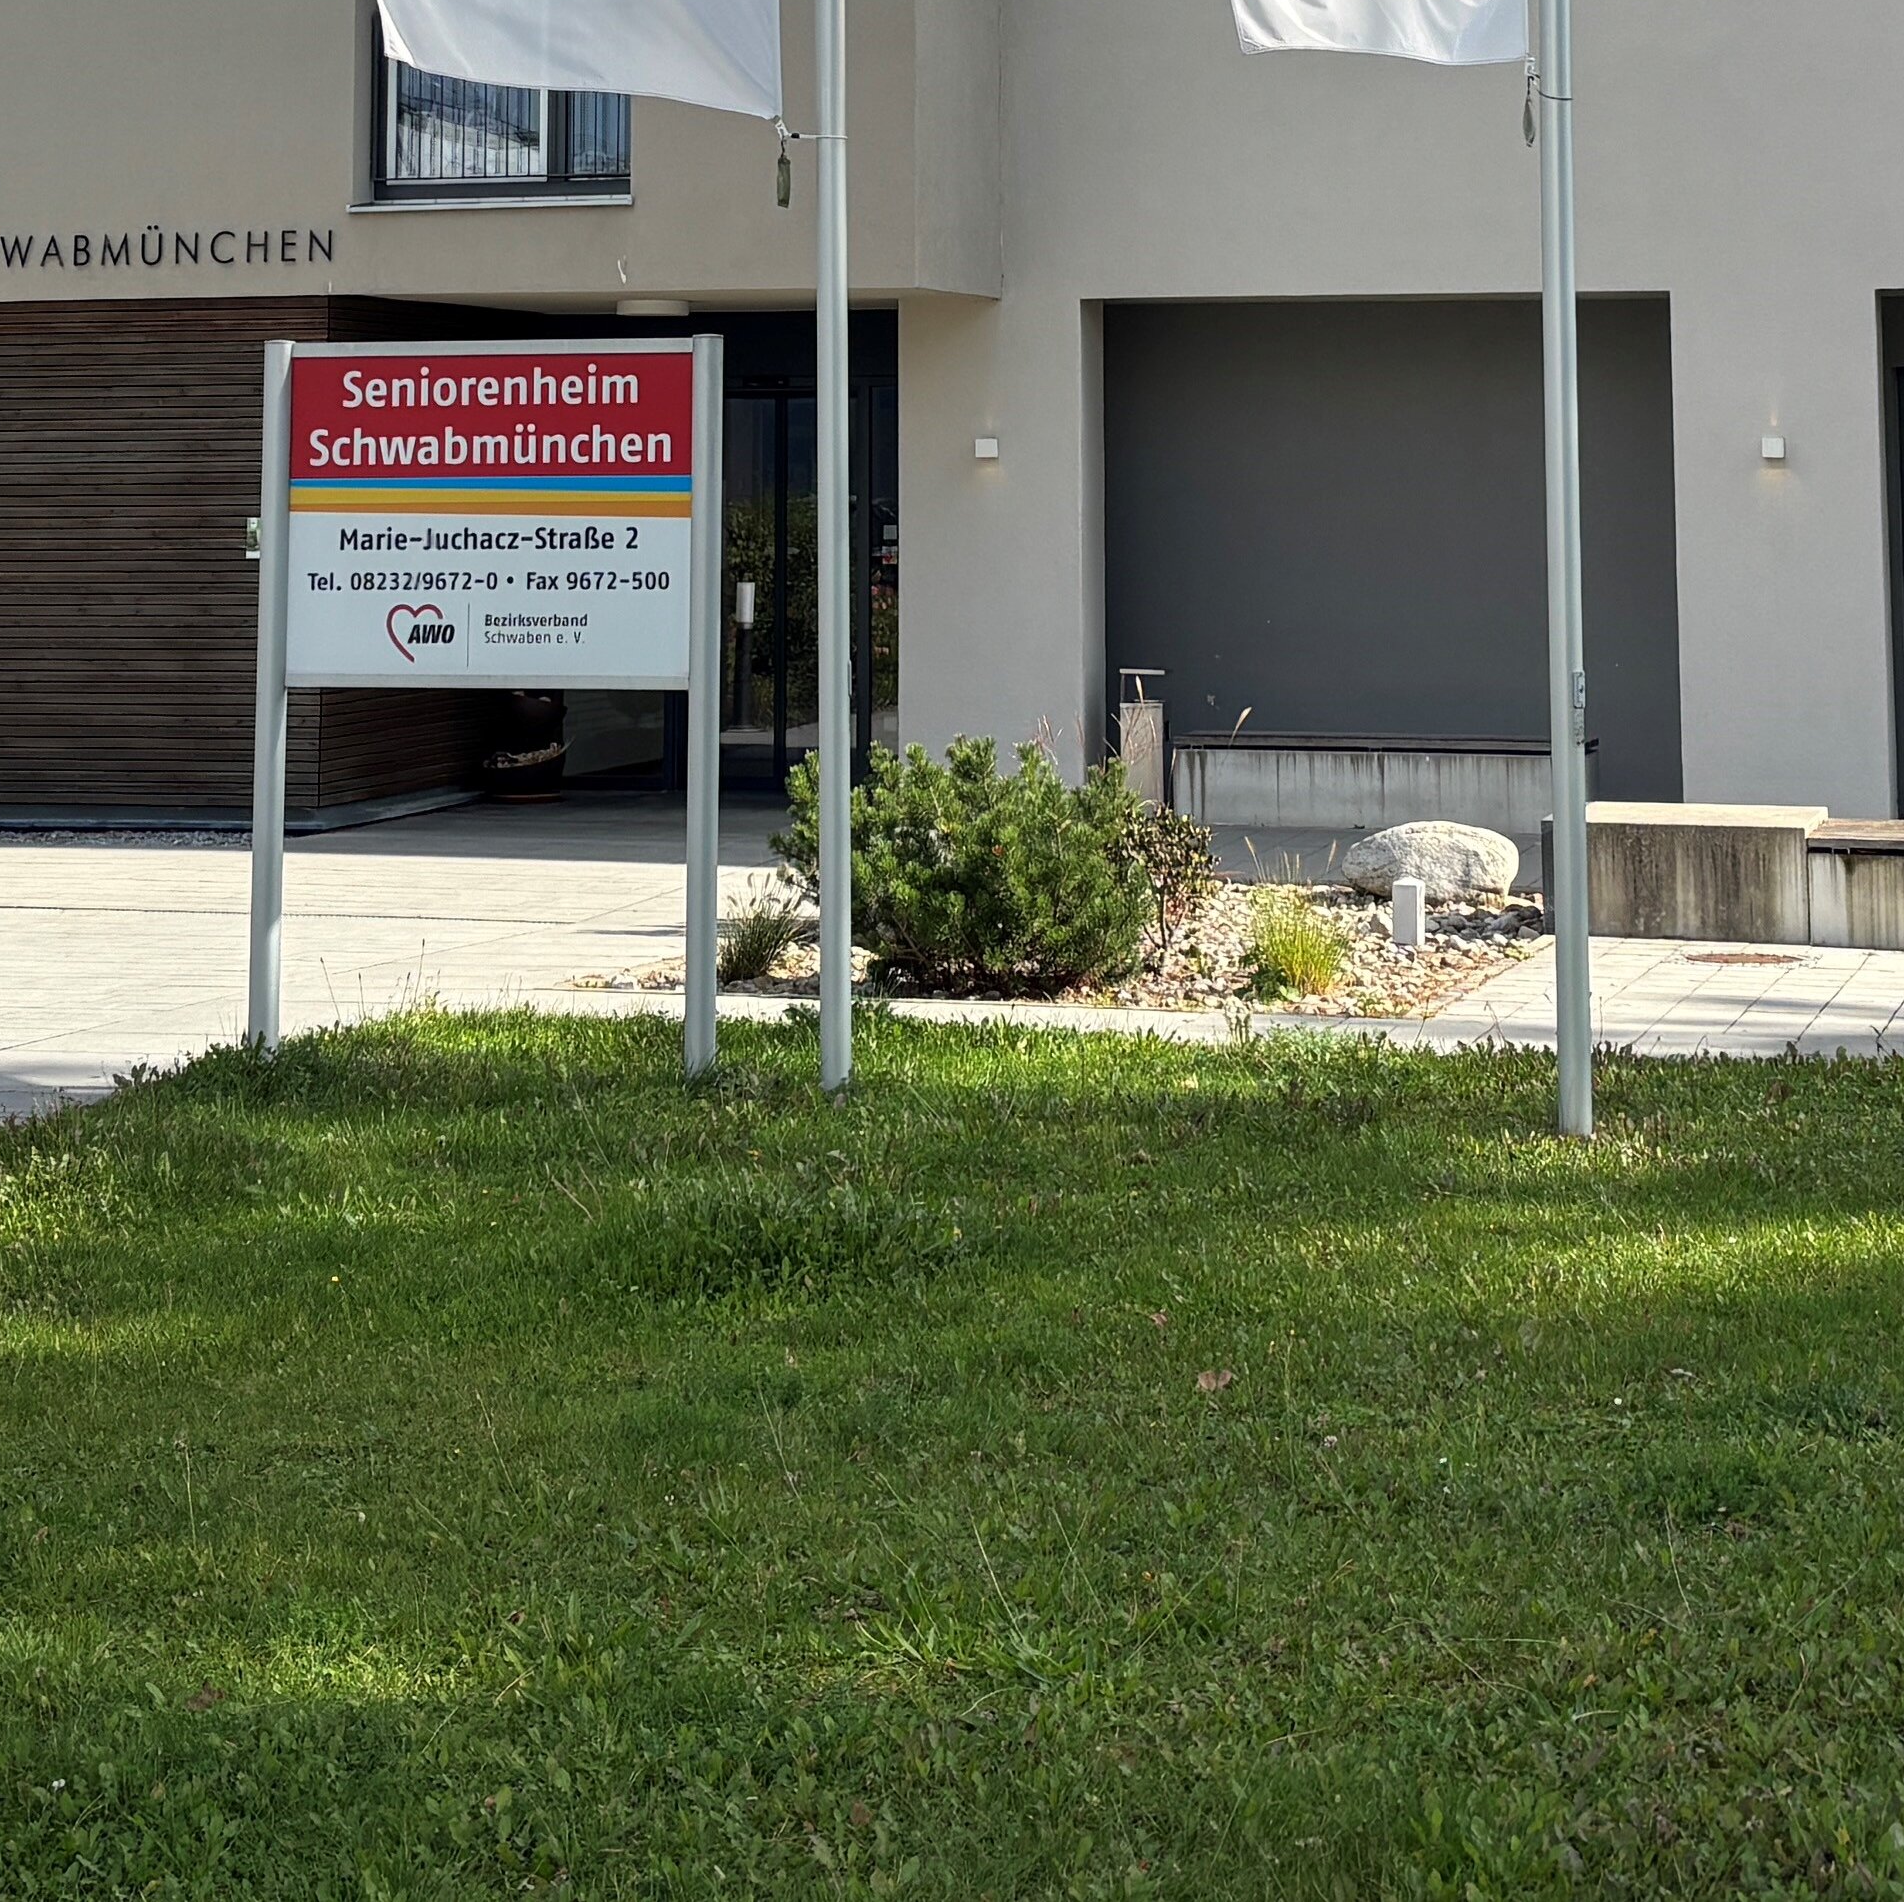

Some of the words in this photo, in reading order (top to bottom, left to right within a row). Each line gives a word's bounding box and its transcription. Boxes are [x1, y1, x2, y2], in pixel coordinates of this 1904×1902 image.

[341, 363, 639, 409] Seniorenheim
[308, 422, 672, 468] Schwabmünchen
[339, 524, 615, 552] Marie-Juchacz-Straße
[625, 526, 639, 551] 2
[306, 571, 342, 592] Tel.
[350, 571, 498, 592] 08232/9672-0
[526, 571, 559, 591] Fax
[566, 571, 671, 591] 9672-500
[484, 612, 589, 629] Bezirksverband
[407, 623, 456, 646] AWO
[484, 629, 552, 645] Schwaben
[555, 632, 569, 645] e.
[573, 630, 586, 645] V.
